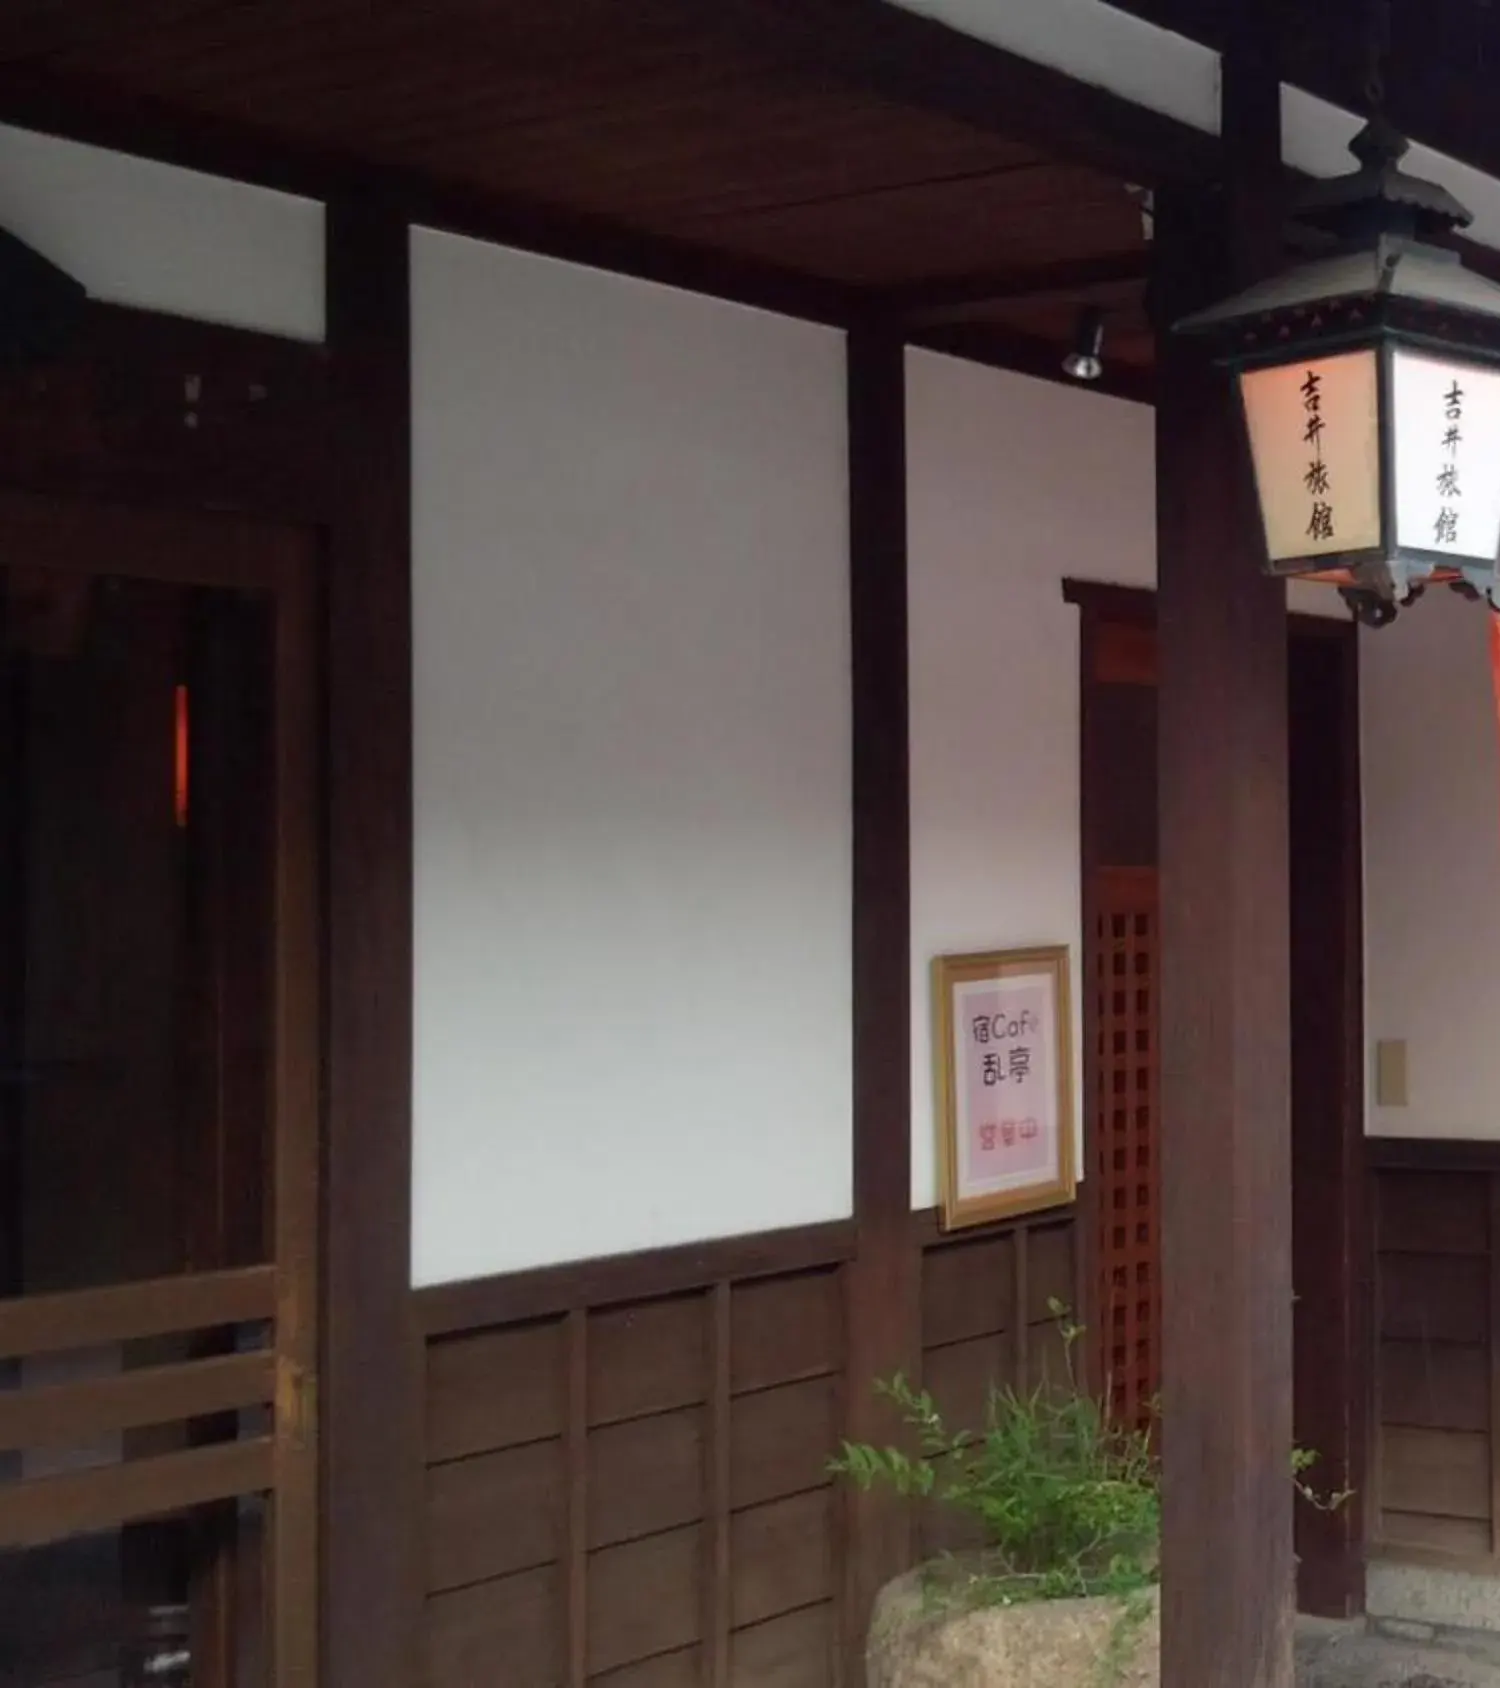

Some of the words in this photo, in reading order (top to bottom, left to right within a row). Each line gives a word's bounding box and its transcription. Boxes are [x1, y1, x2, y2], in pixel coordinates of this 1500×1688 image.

[1300, 370, 1334, 540] 吉井旅館
[1433, 380, 1465, 543] 吉井旅館
